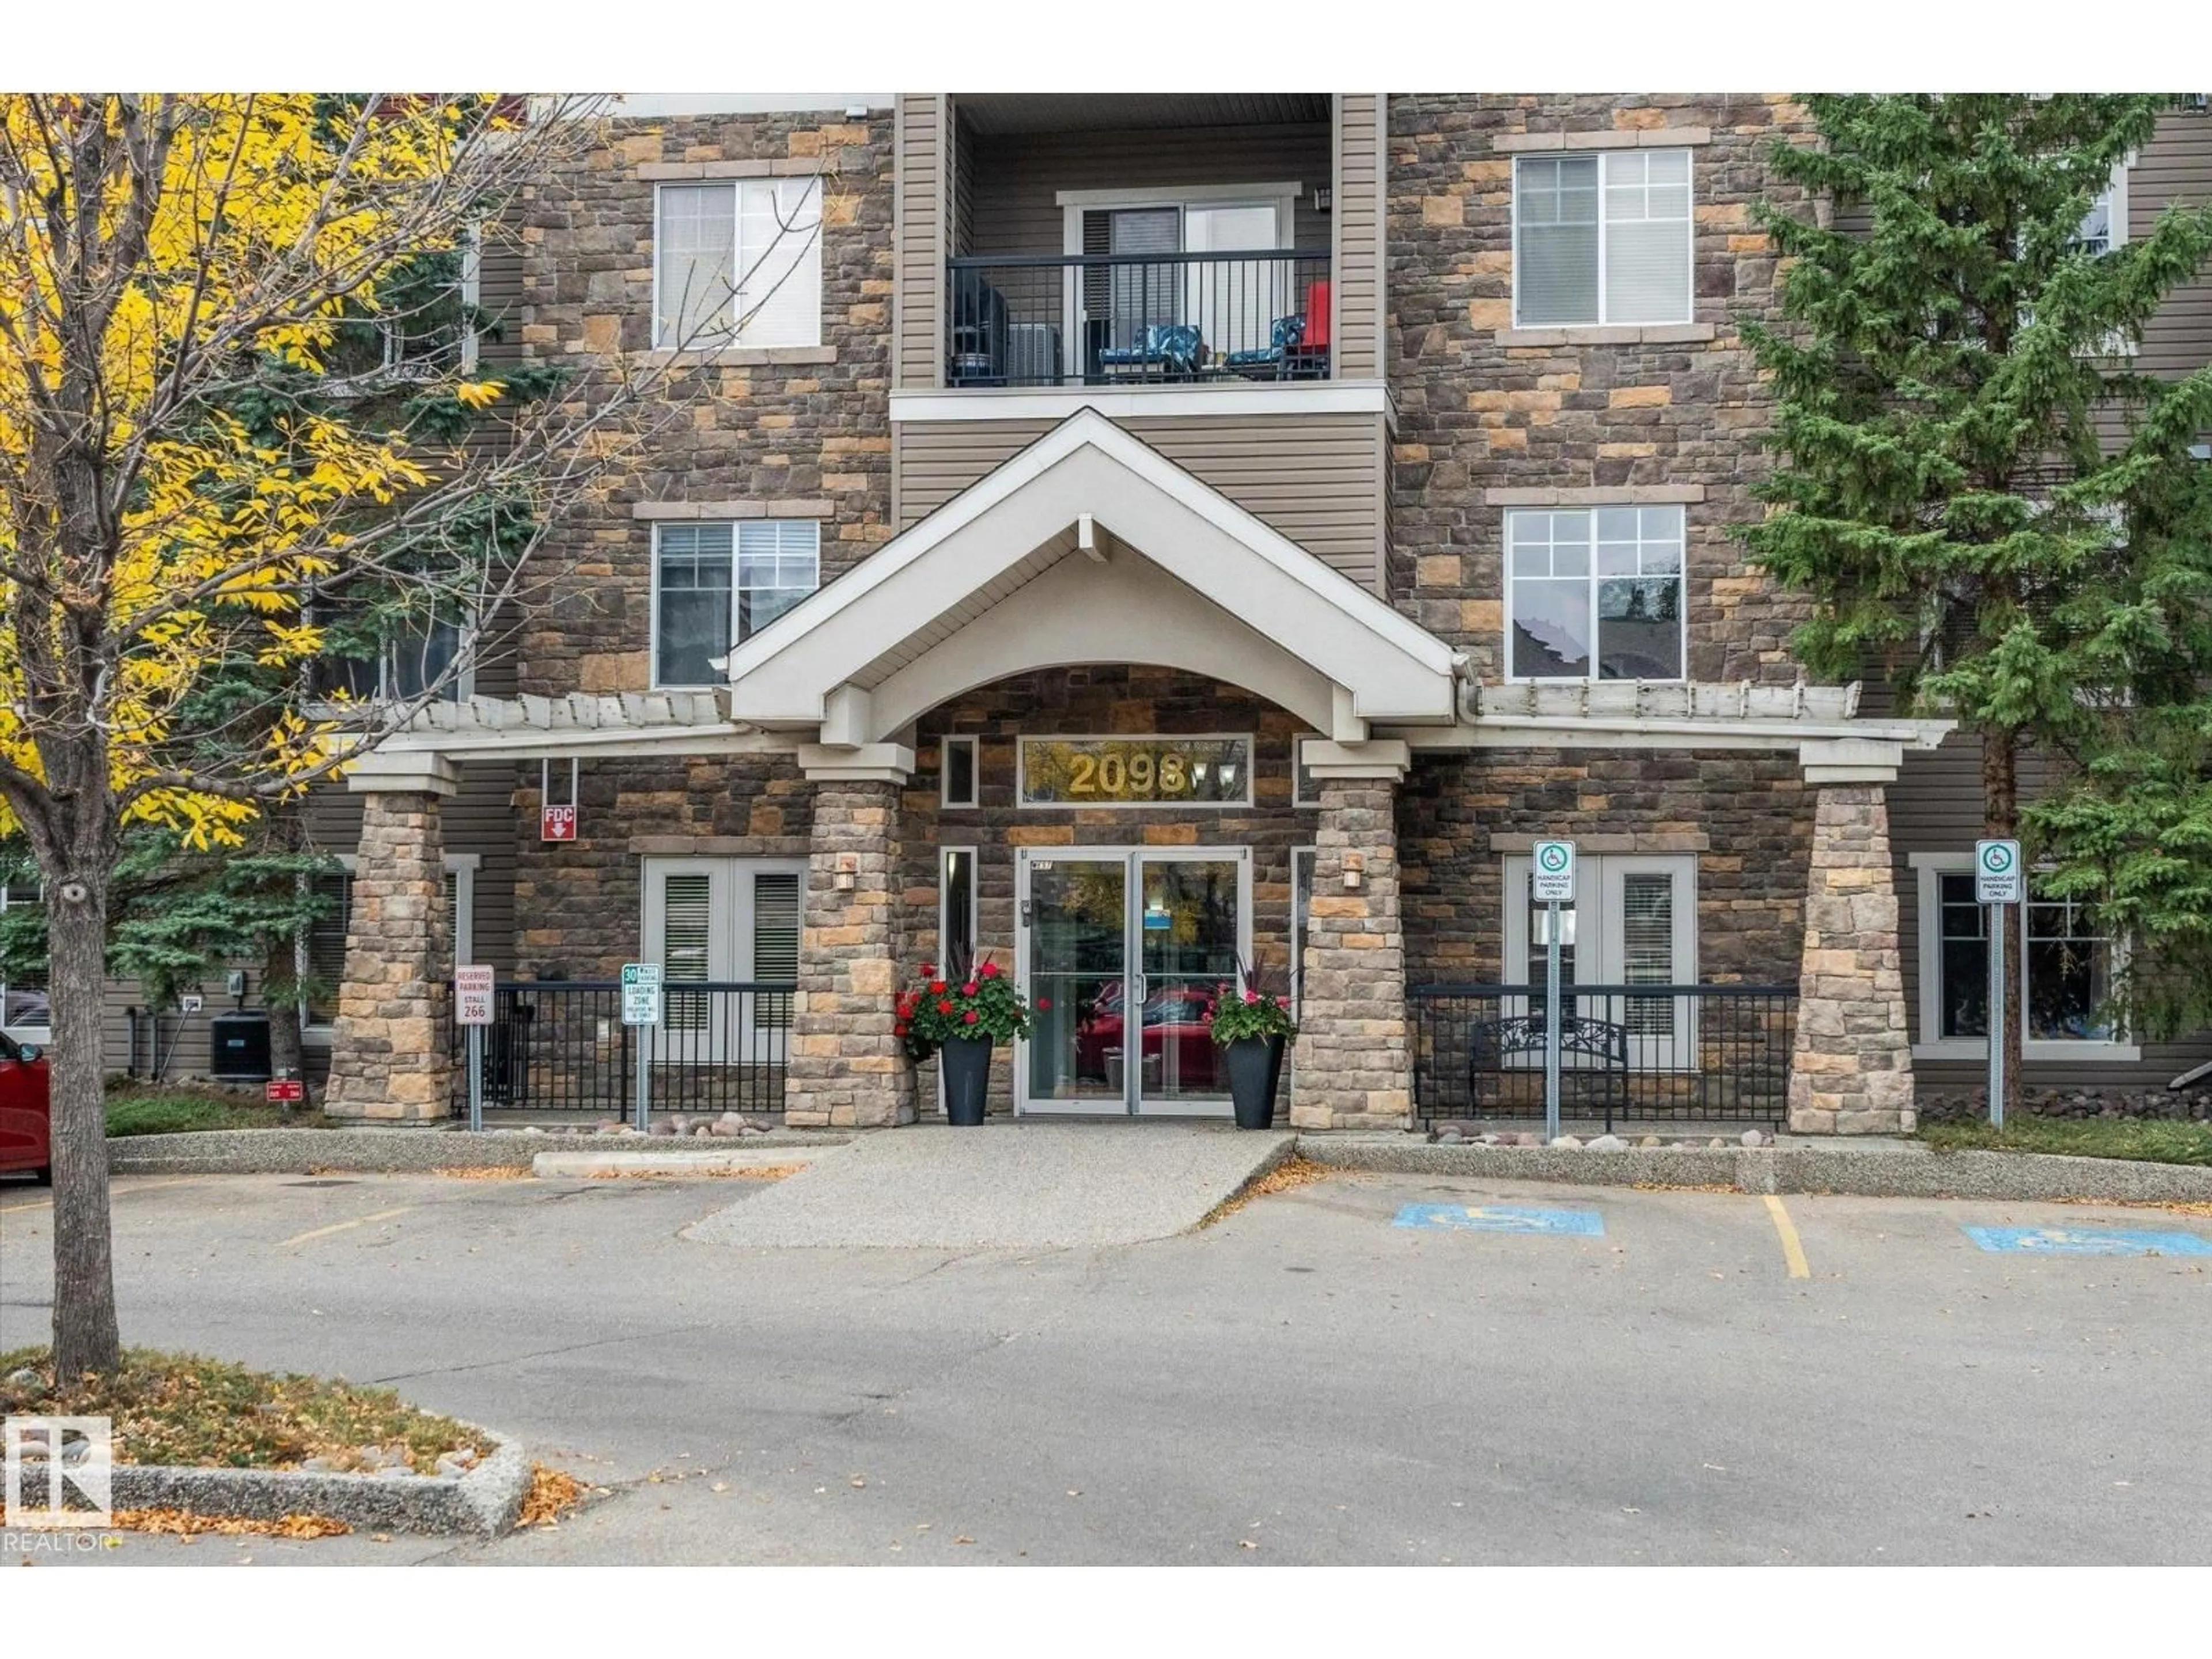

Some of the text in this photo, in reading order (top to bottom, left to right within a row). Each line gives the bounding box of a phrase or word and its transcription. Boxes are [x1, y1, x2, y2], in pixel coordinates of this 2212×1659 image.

[1070, 753, 1185, 792] 2098
[545, 808, 573, 823] FDC
[458, 972, 490, 980] RESERVED
[624, 968, 637, 982] 30
[459, 982, 490, 991] PARKING
[628, 986, 655, 994] LOADING
[634, 996, 649, 1005] ZONE
[464, 1005, 486, 1017] 266
